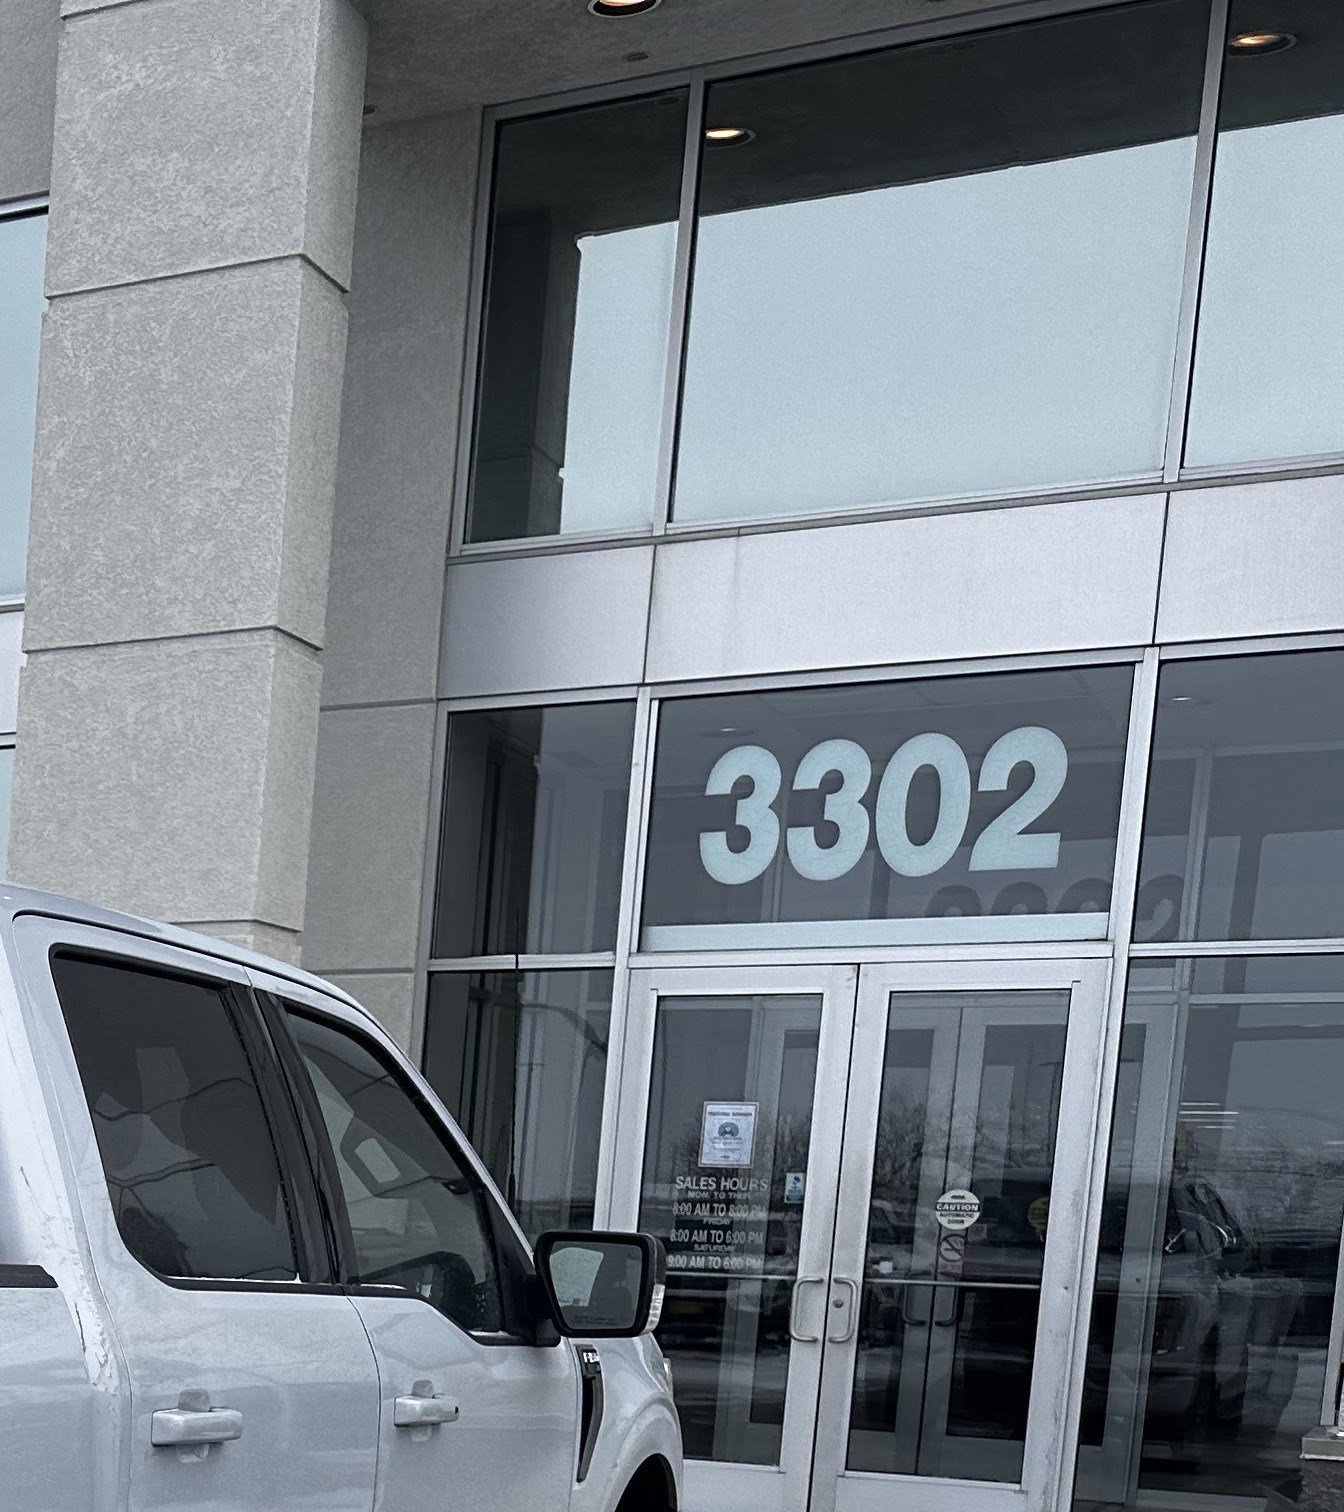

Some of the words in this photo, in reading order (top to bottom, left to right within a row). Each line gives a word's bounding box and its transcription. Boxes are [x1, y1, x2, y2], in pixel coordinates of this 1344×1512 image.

[699, 726, 1069, 886] 3302
[675, 1175, 717, 1190] SALES
[720, 1176, 769, 1191] HOURS
[687, 1190, 709, 1198] MON
[713, 1190, 726, 1200] TO
[672, 1201, 693, 1216] 8:00
[693, 1202, 711, 1217] AM
[712, 1203, 727, 1217] TO
[936, 1203, 979, 1211] CAUTION
[691, 1229, 708, 1243] AM
[709, 1229, 724, 1243] TO
[666, 1254, 688, 1269] 9:00
[688, 1255, 706, 1269] AM
[707, 1256, 722, 1270] TO
